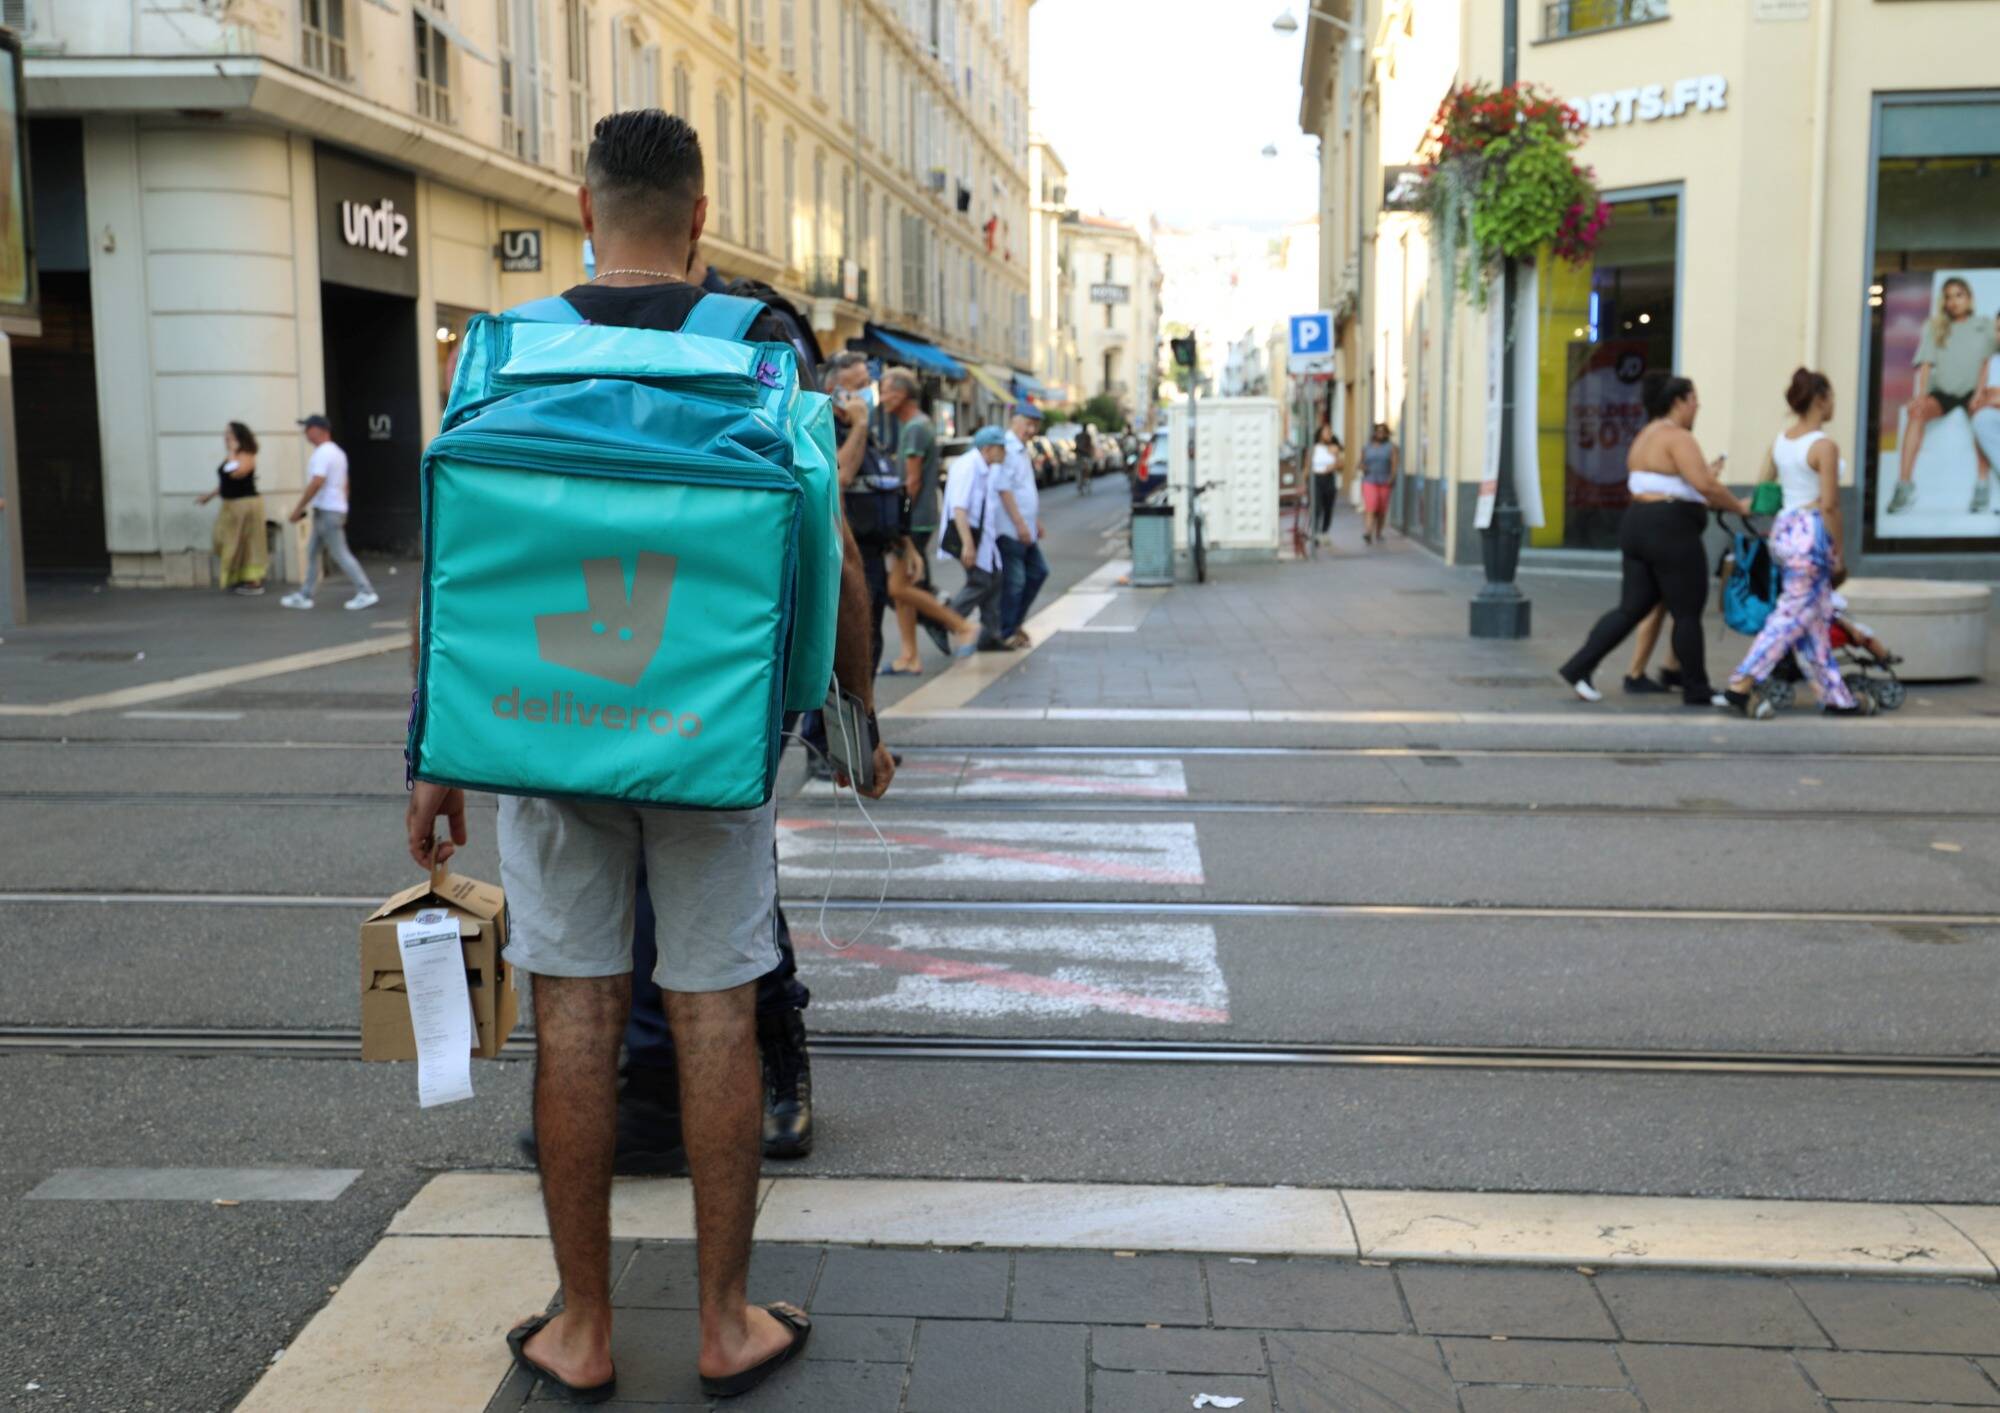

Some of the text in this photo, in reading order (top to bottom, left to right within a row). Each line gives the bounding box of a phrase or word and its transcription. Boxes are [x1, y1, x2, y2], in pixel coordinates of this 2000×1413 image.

[342, 199, 409, 257] undiz
[1299, 320, 1321, 350] P
[491, 686, 704, 740] deliveroo
